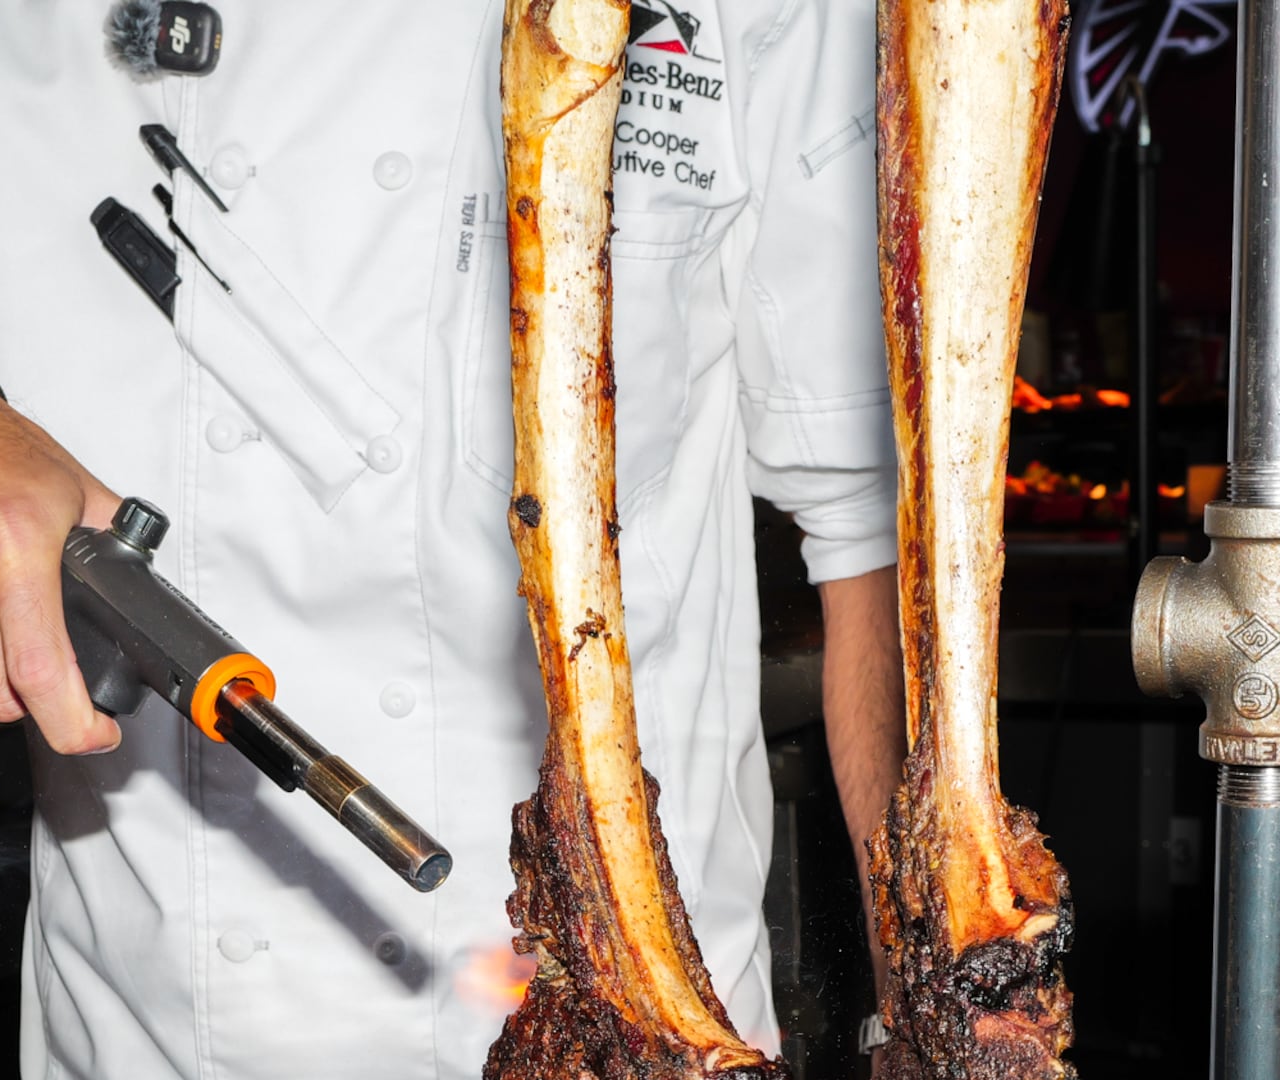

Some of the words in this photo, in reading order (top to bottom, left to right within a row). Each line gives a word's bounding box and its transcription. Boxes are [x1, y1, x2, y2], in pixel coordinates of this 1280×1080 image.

[168, 15, 191, 54] dji
[615, 121, 699, 156] Cooper
[674, 161, 716, 190] Chef
[460, 193, 478, 226] ROLL
[455, 231, 474, 273] CHEFS
